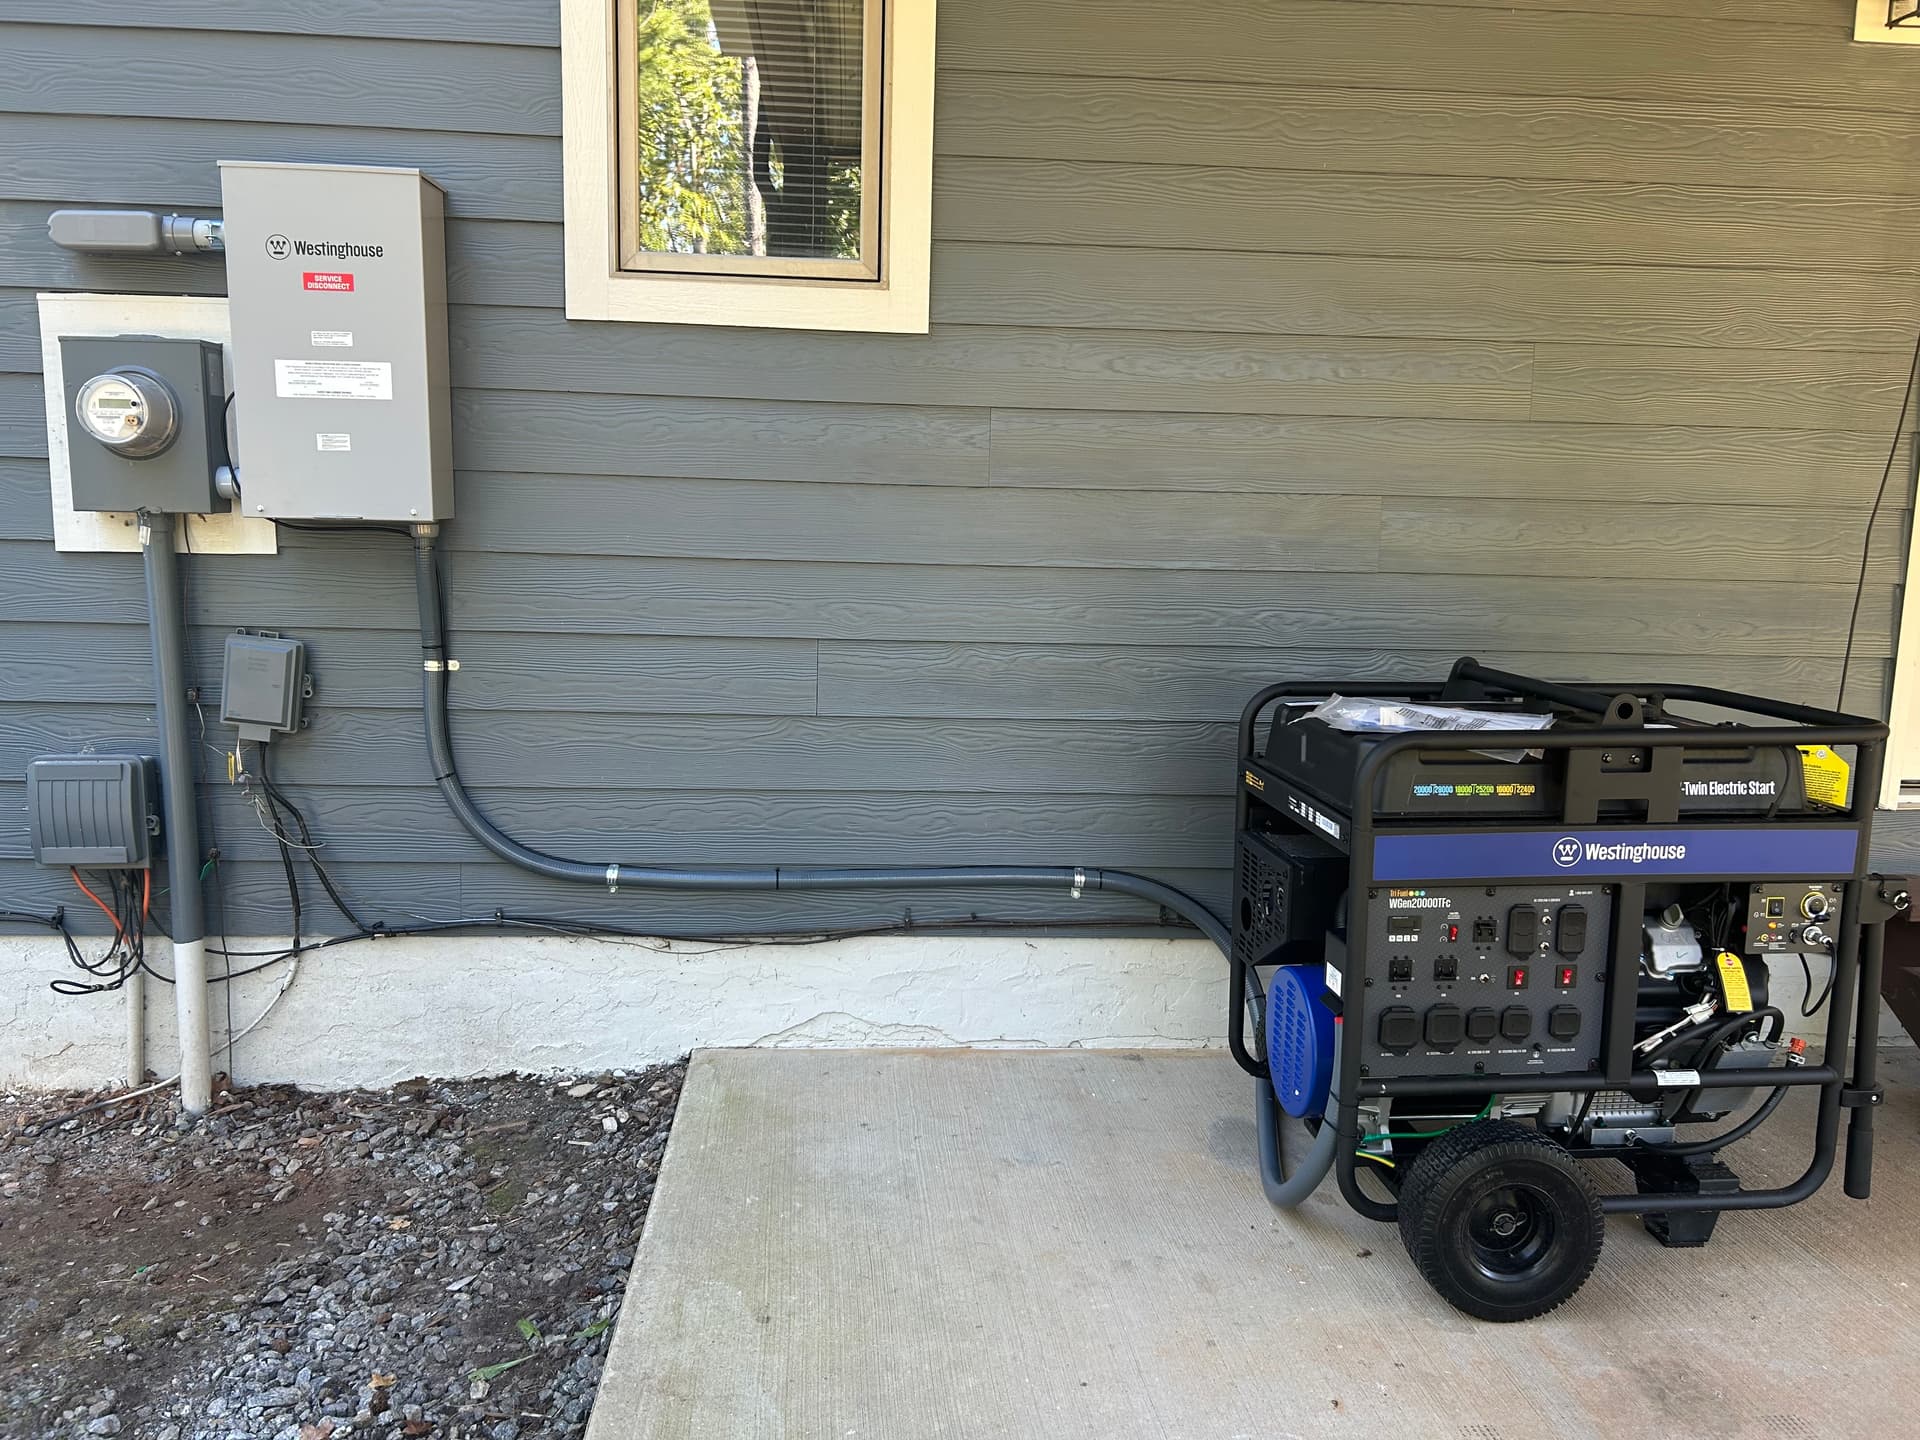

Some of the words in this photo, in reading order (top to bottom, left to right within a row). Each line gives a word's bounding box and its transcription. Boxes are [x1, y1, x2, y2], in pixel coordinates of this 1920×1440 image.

[294, 240, 384, 260] Westinghouse
[307, 282, 351, 290] DISCONNECT
[314, 275, 343, 283] SERVICE
[1680, 781, 1708, 796] -Twin
[1709, 781, 1747, 796] Electric
[1748, 780, 1776, 796] Start
[1585, 843, 1686, 864] Westinghouse
[1389, 897, 1452, 909] WGen20000TFc
